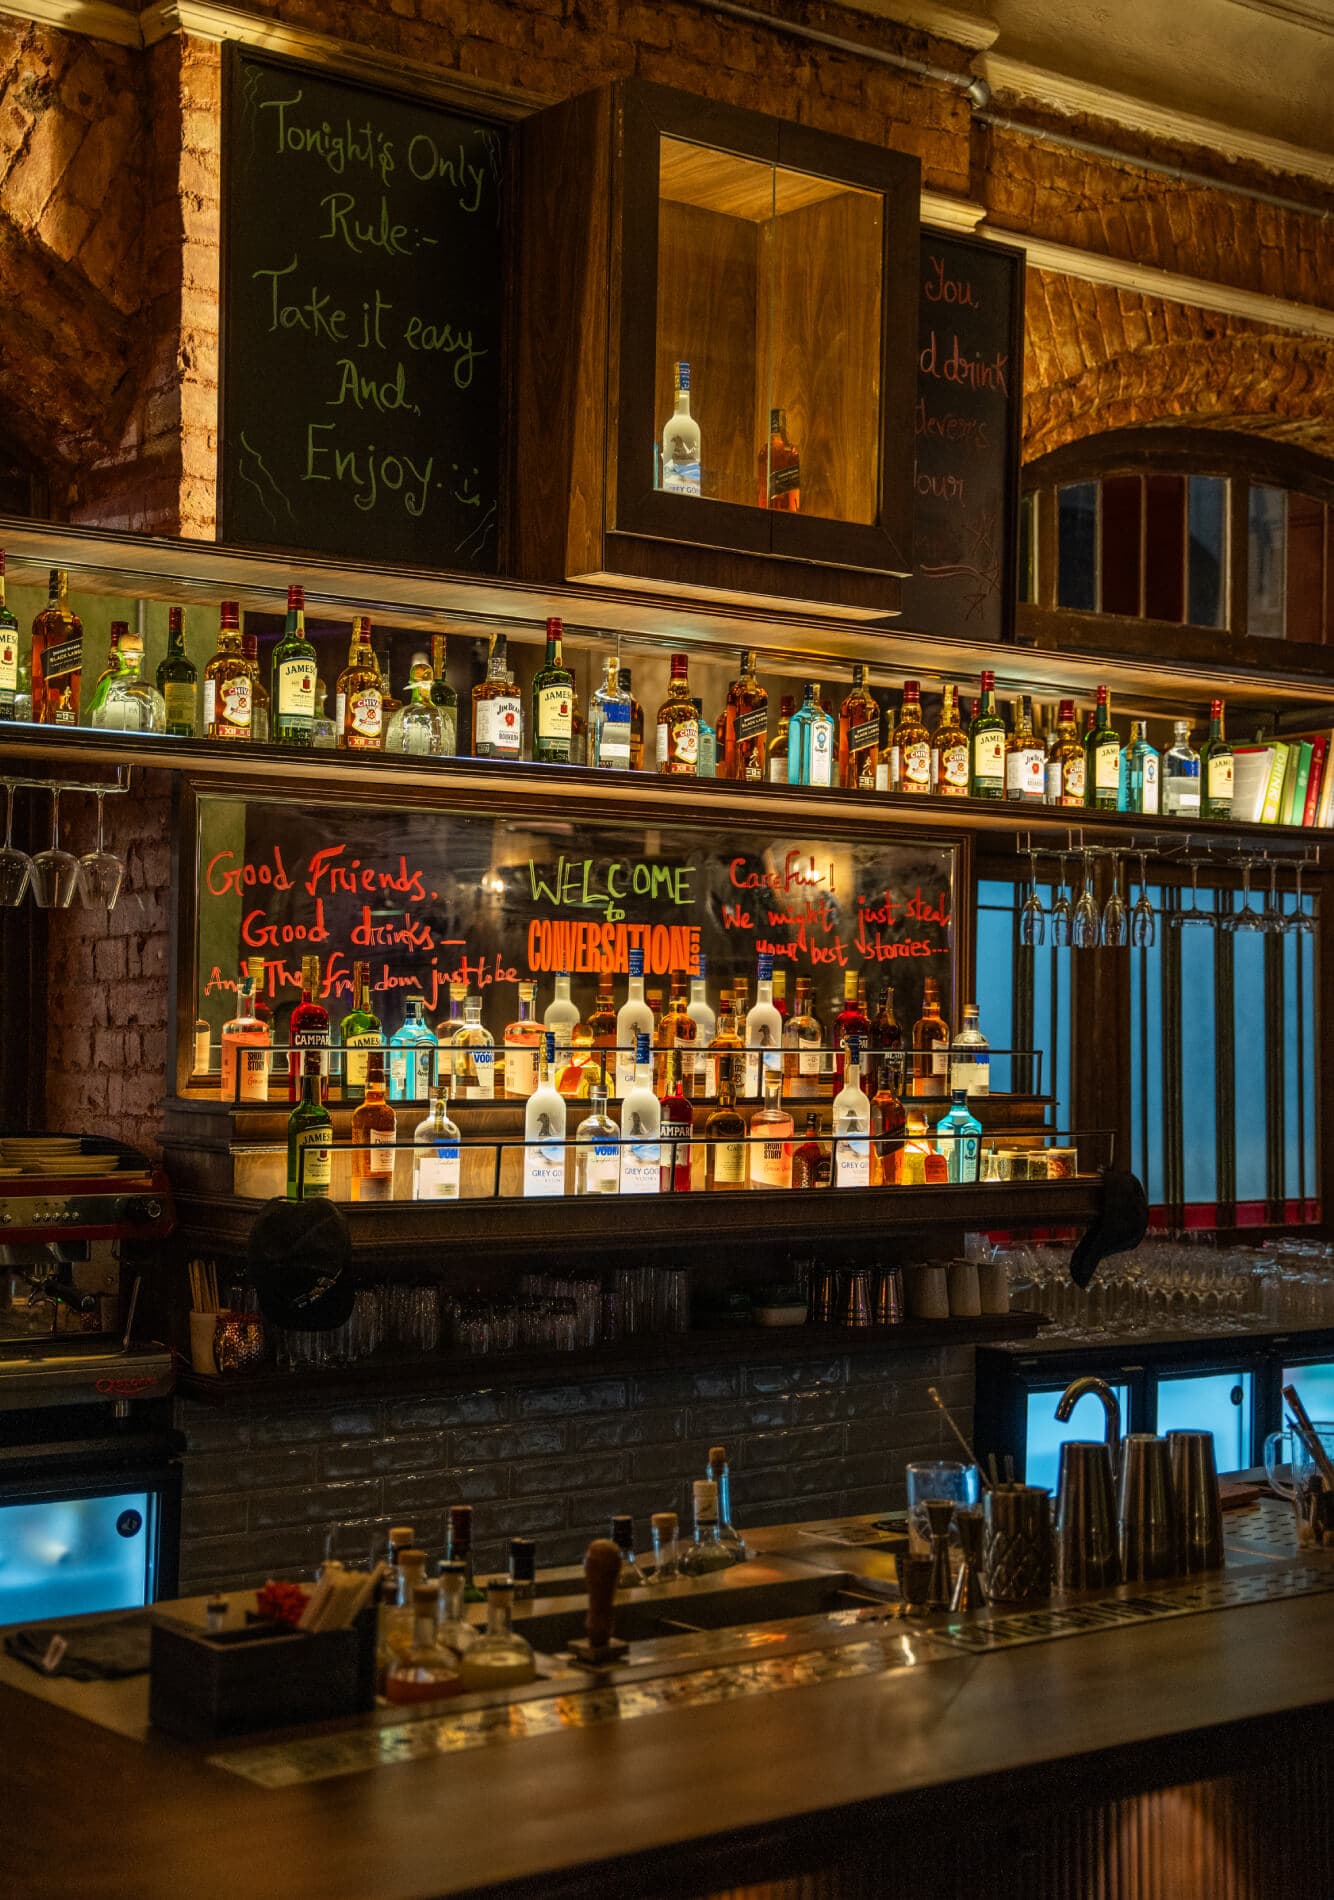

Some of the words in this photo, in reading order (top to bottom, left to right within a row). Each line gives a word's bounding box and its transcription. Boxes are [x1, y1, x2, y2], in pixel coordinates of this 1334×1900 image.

[260, 90, 394, 186] Tonight's
[408, 134, 484, 212] Only
[253, 254, 348, 339] Take
[358, 289, 393, 349] it
[405, 315, 488, 388] easy
[943, 335, 1009, 398] drink
[285, 664, 315, 676] JAMES
[207, 845, 296, 897] Good
[528, 855, 697, 906] WELCOME
[241, 897, 330, 947] Good
[603, 900, 626, 922] to
[722, 903, 754, 929] We
[767, 897, 836, 953] might
[854, 888, 900, 954] just
[528, 919, 690, 975] CONVERSATION
[810, 935, 849, 967] best
[423, 956, 472, 1011] just
[763, 1150, 782, 1159] STORY
